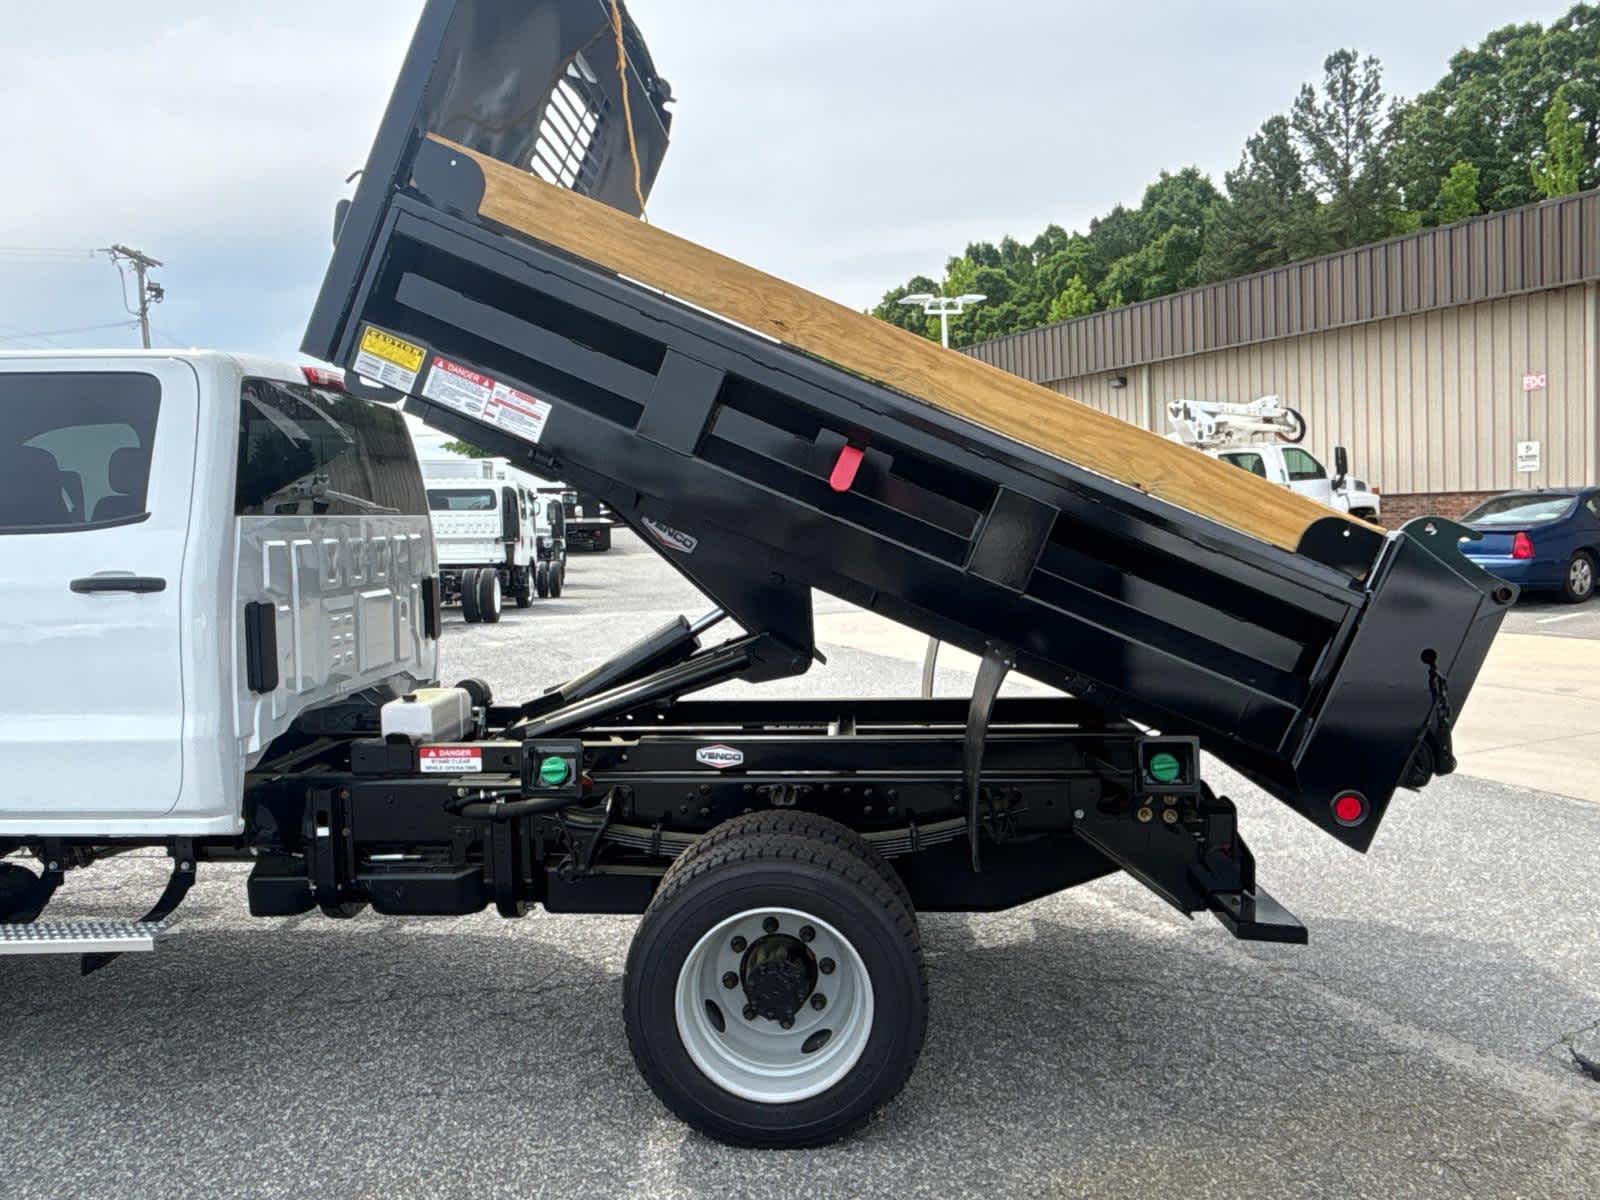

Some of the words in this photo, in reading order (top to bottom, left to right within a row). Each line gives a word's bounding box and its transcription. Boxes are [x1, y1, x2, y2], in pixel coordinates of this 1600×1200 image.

[447, 363, 481, 383] DANGER
[439, 749, 472, 757] DANGER
[700, 751, 742, 761] VENCO
